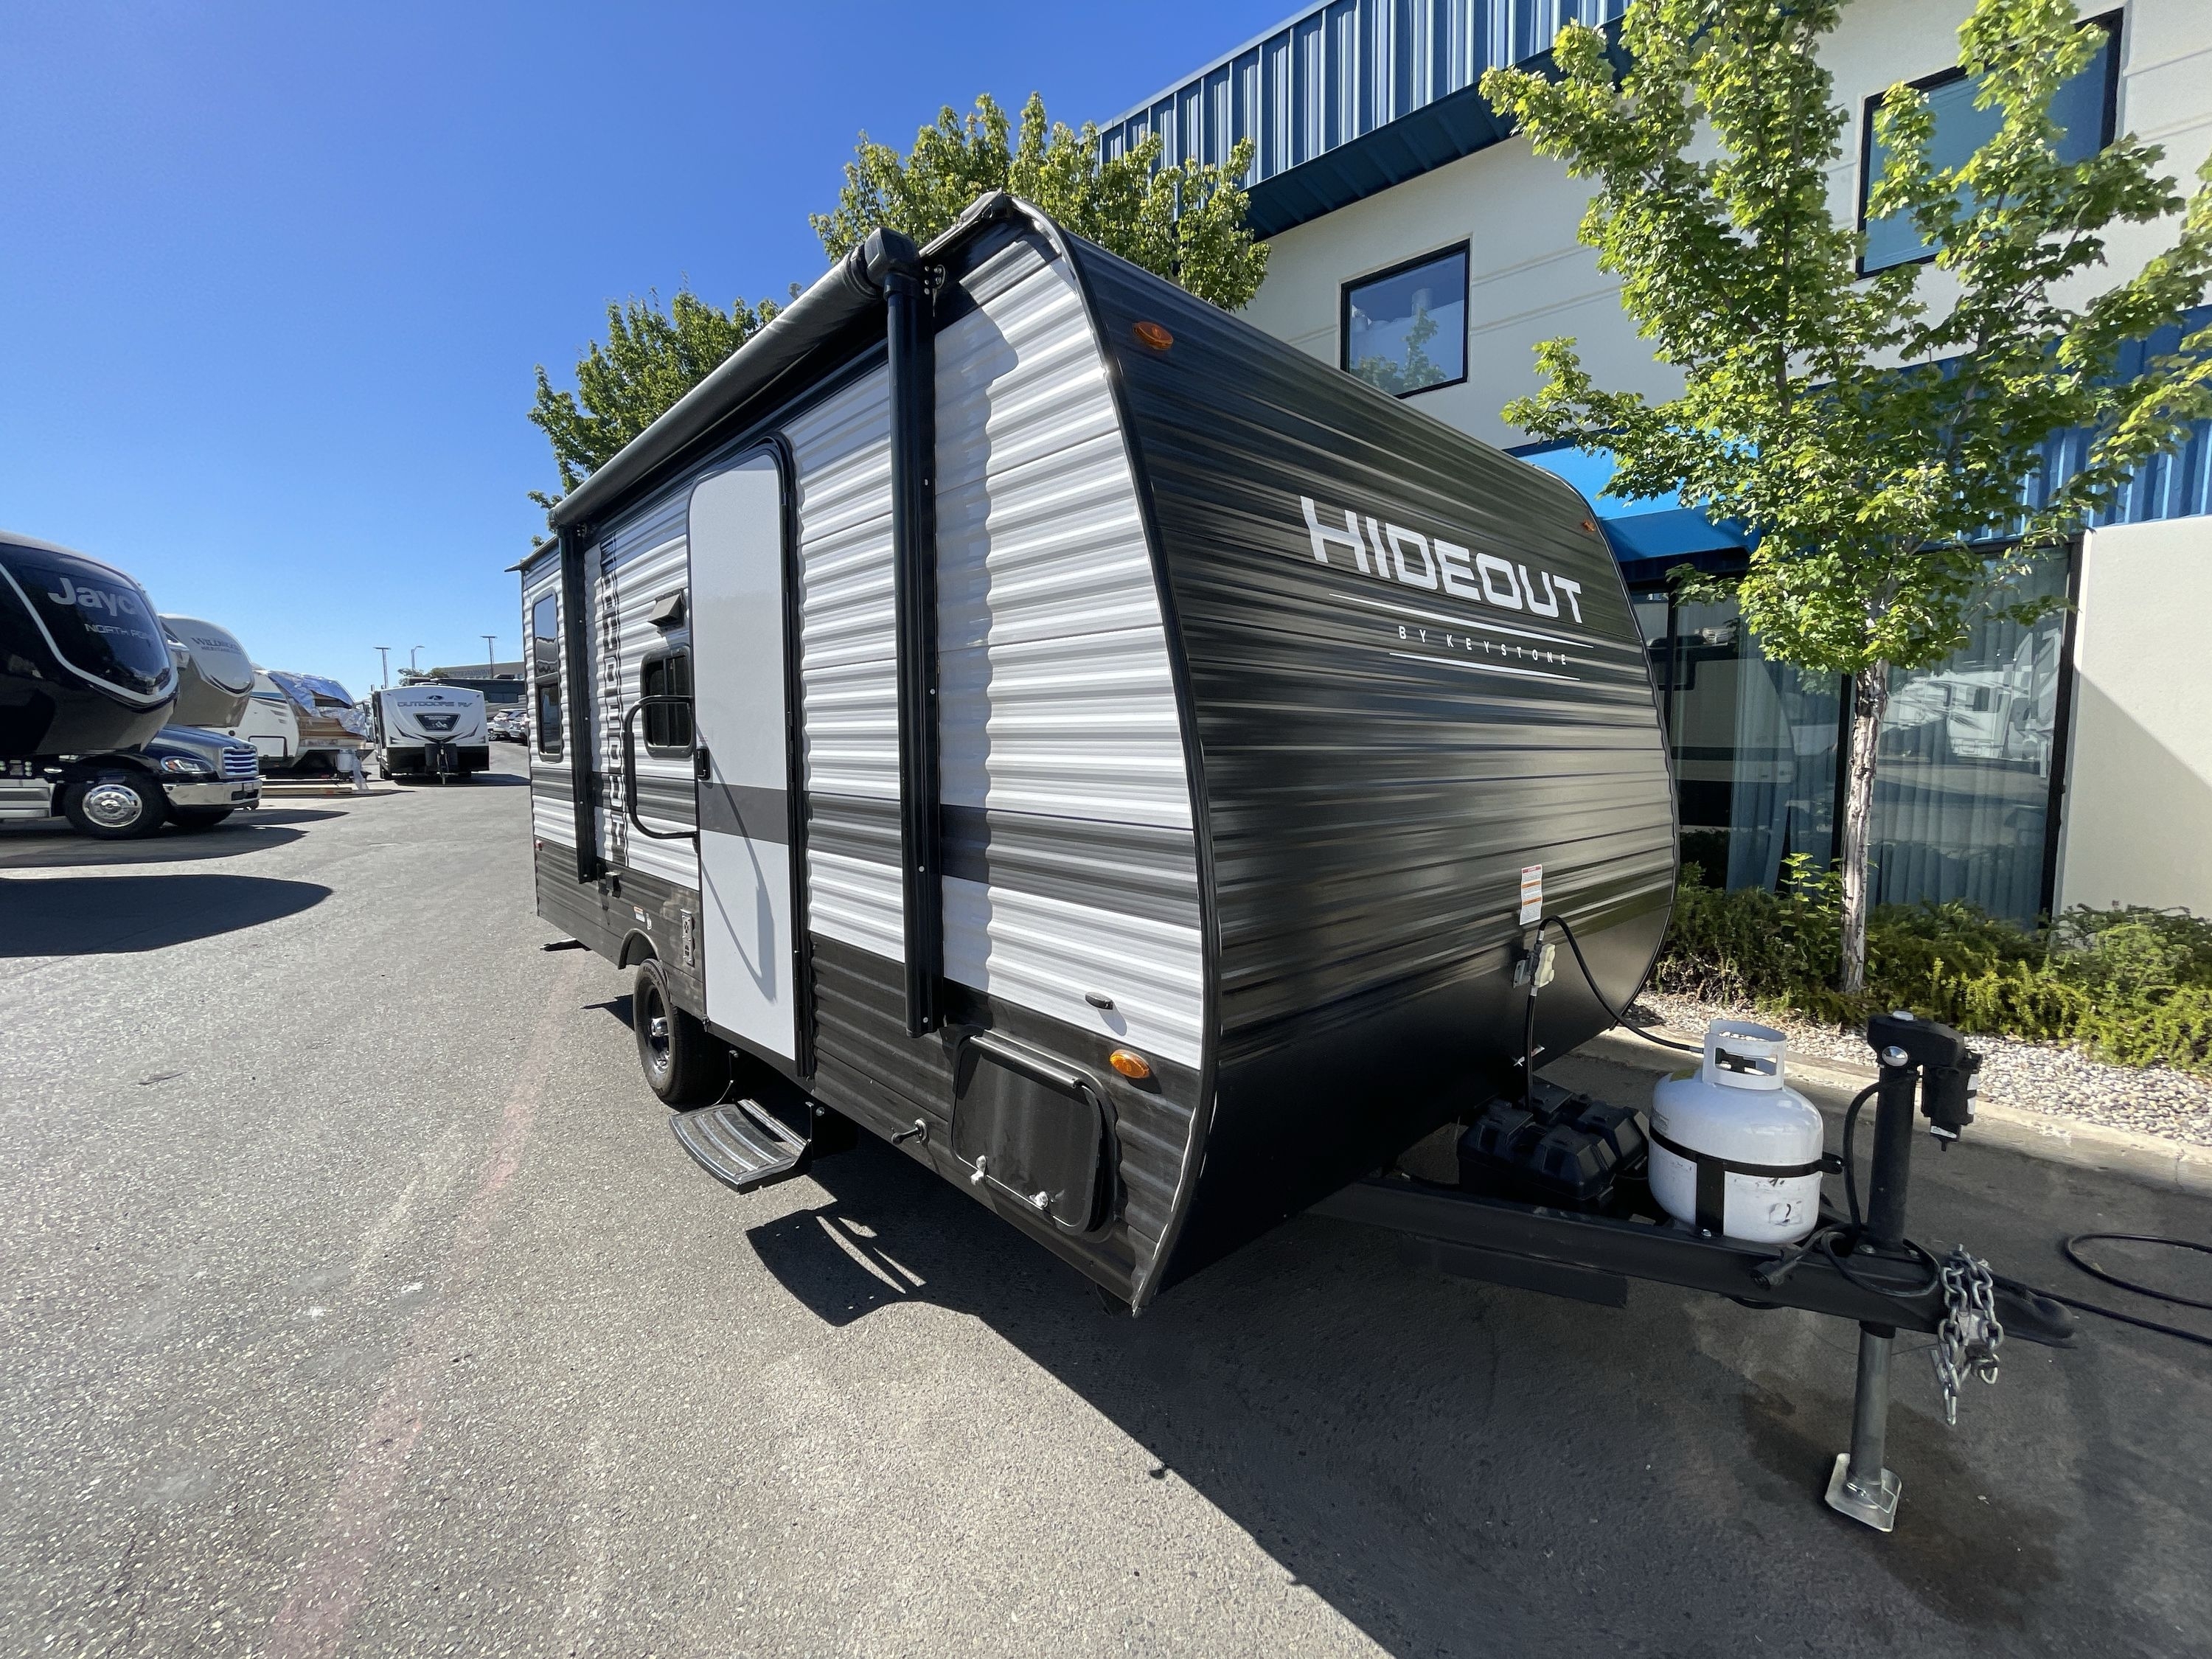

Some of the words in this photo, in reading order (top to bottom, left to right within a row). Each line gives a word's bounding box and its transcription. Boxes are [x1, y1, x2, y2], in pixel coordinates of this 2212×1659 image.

[1300, 495, 1582, 624] HIDEOUT
[1399, 625, 1427, 643] BY
[1446, 633, 1567, 665] KEYSTONE
[601, 575, 625, 846] HIDEOUT
